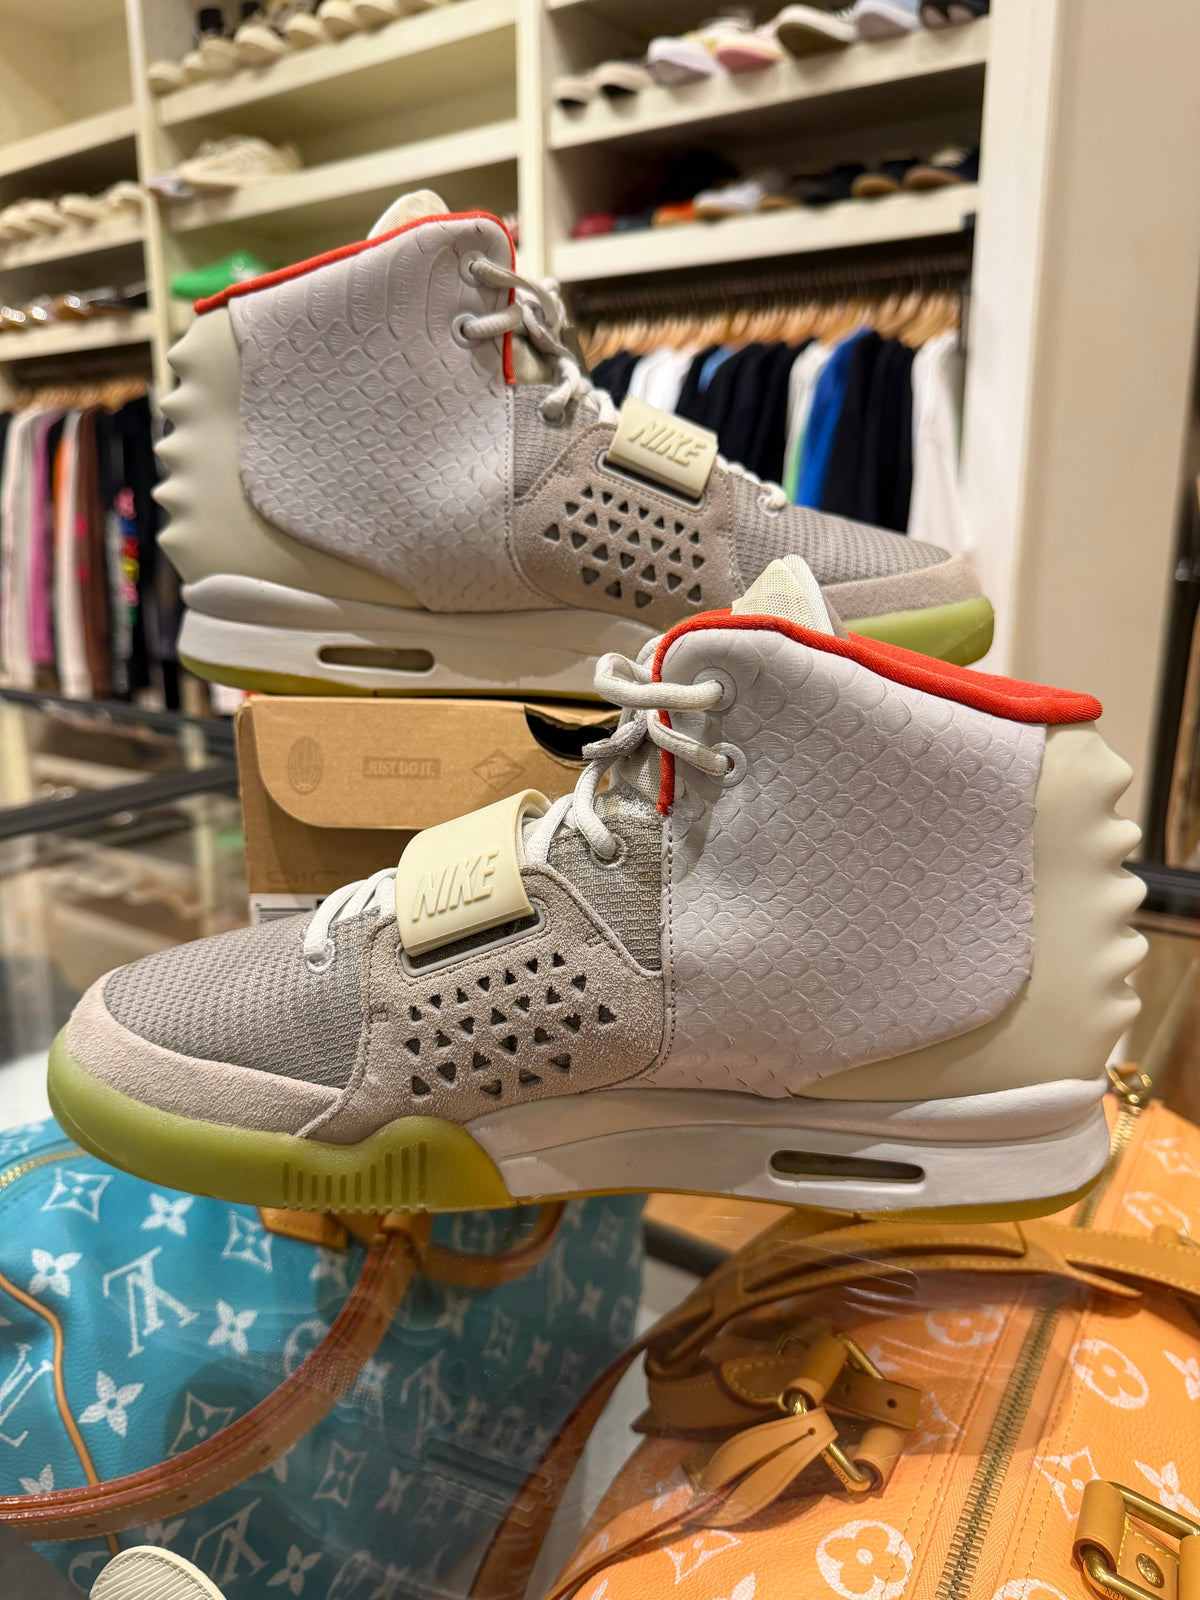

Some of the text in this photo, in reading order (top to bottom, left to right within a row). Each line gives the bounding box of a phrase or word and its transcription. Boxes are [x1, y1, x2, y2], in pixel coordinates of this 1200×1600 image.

[627, 420, 708, 467] NIKE
[366, 760, 397, 775] JUST
[399, 760, 419, 775] DO
[411, 848, 500, 924] NIKE
